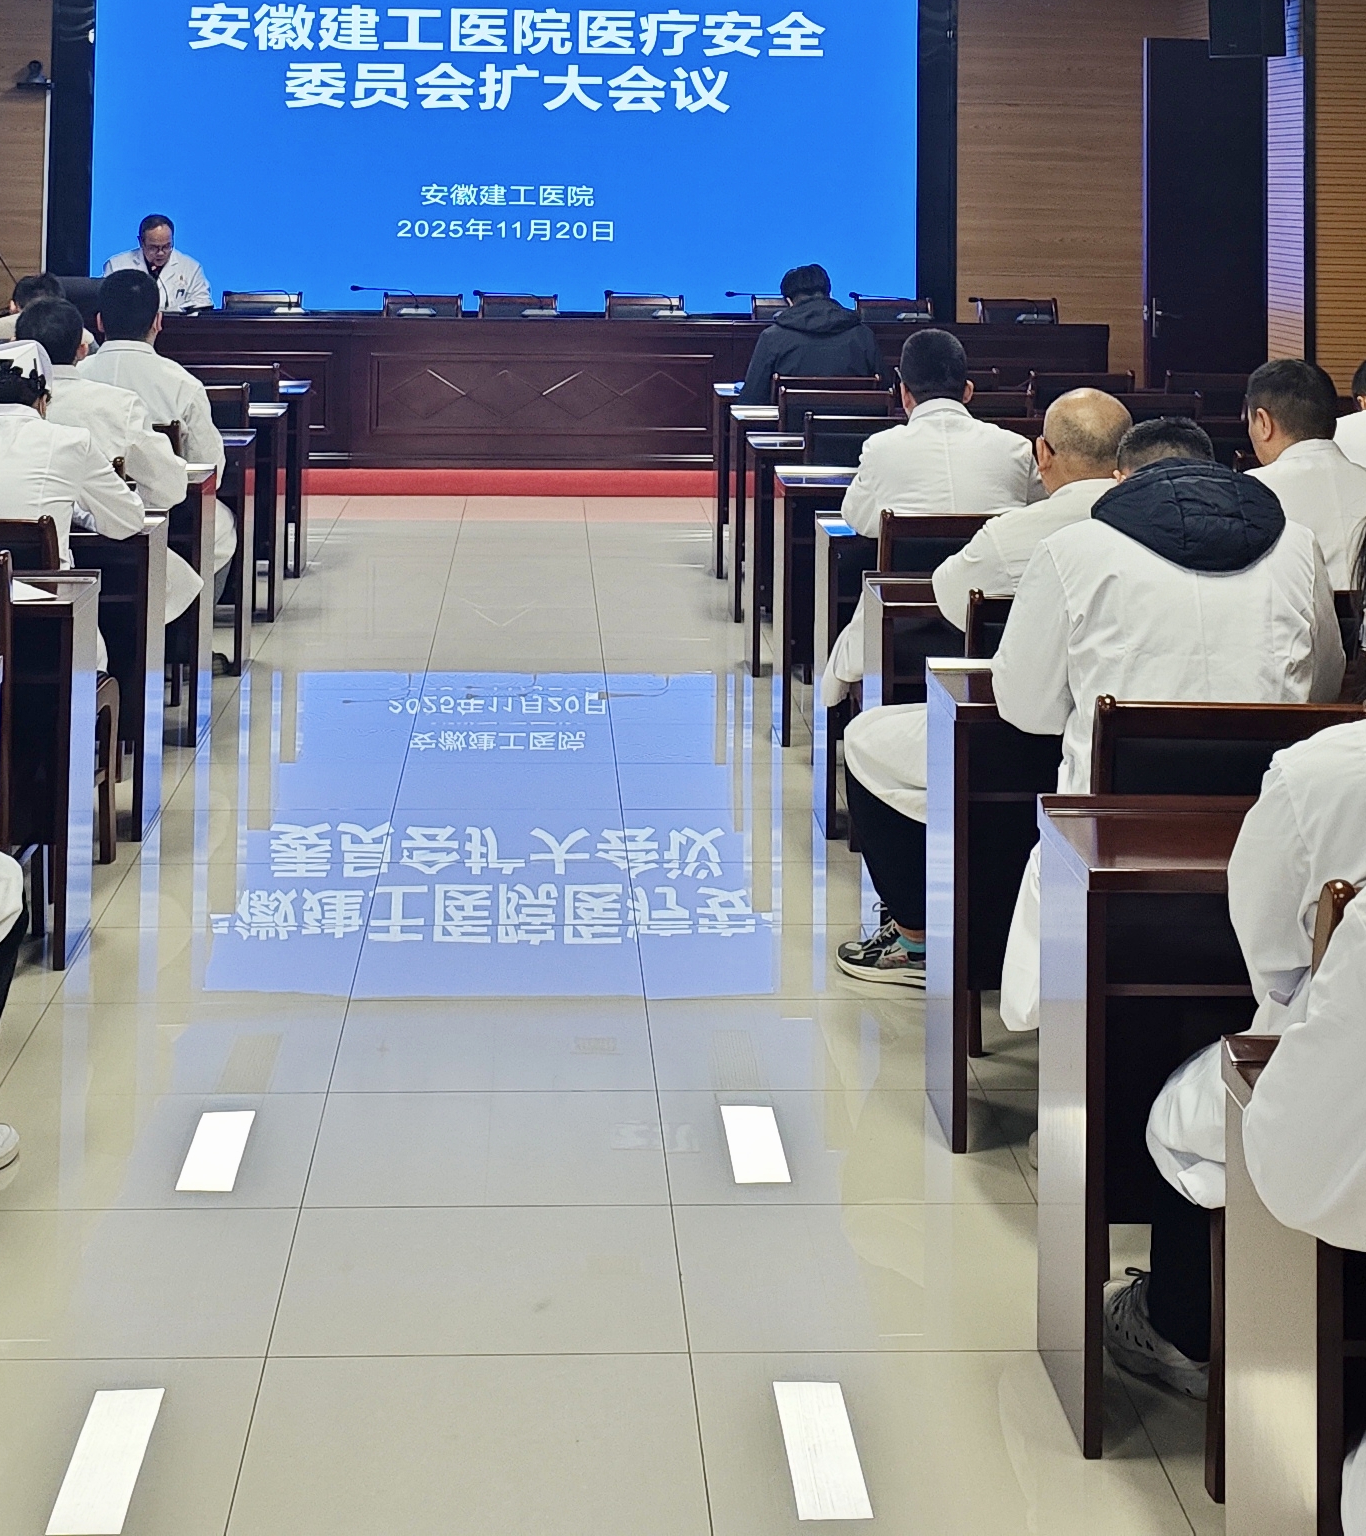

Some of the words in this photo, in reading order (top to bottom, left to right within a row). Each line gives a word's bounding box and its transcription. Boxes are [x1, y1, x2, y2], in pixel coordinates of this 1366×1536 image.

[187, 2, 826, 58] 安徽建工医院医疗安全
[285, 62, 731, 114] 委员会扩大会议
[420, 183, 595, 207] 安徽建工医院
[396, 218, 615, 242] 2025年11月20日
